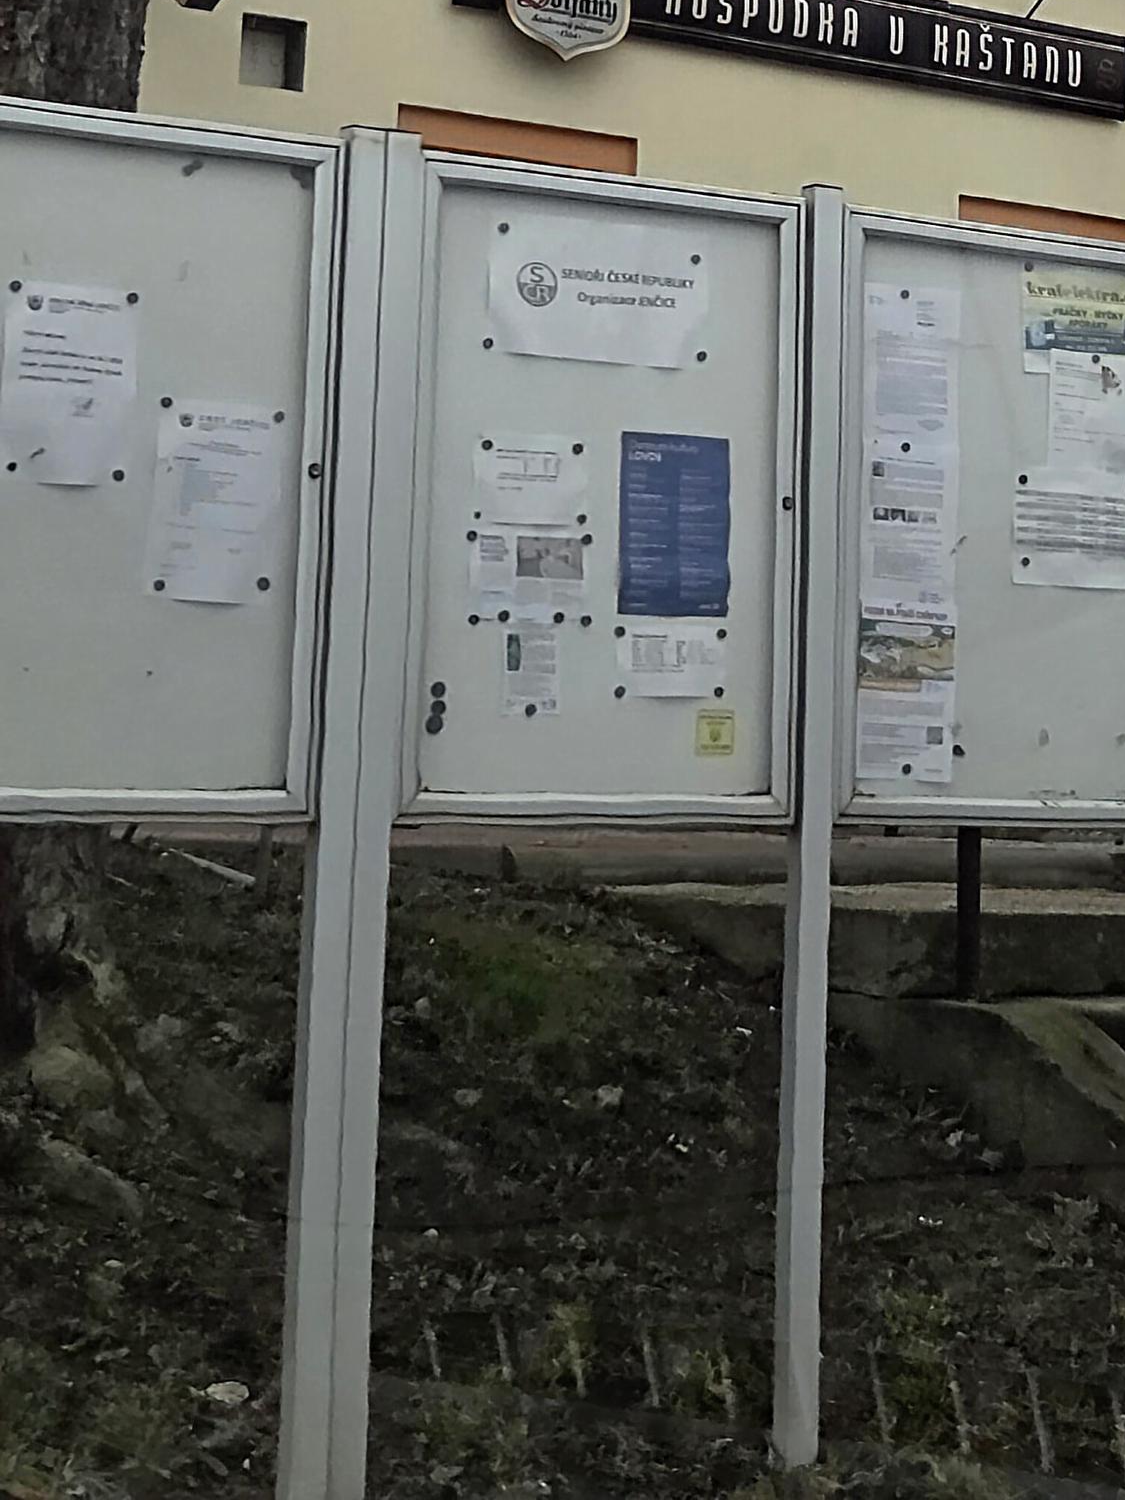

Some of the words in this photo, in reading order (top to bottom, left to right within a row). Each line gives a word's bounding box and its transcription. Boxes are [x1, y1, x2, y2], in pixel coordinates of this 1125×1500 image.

[889, 15, 904, 55] U
[933, 23, 1081, 87] KAŠTANU
[642, 274, 695, 289] REPUBLIKY
[577, 291, 636, 306] Organizace
